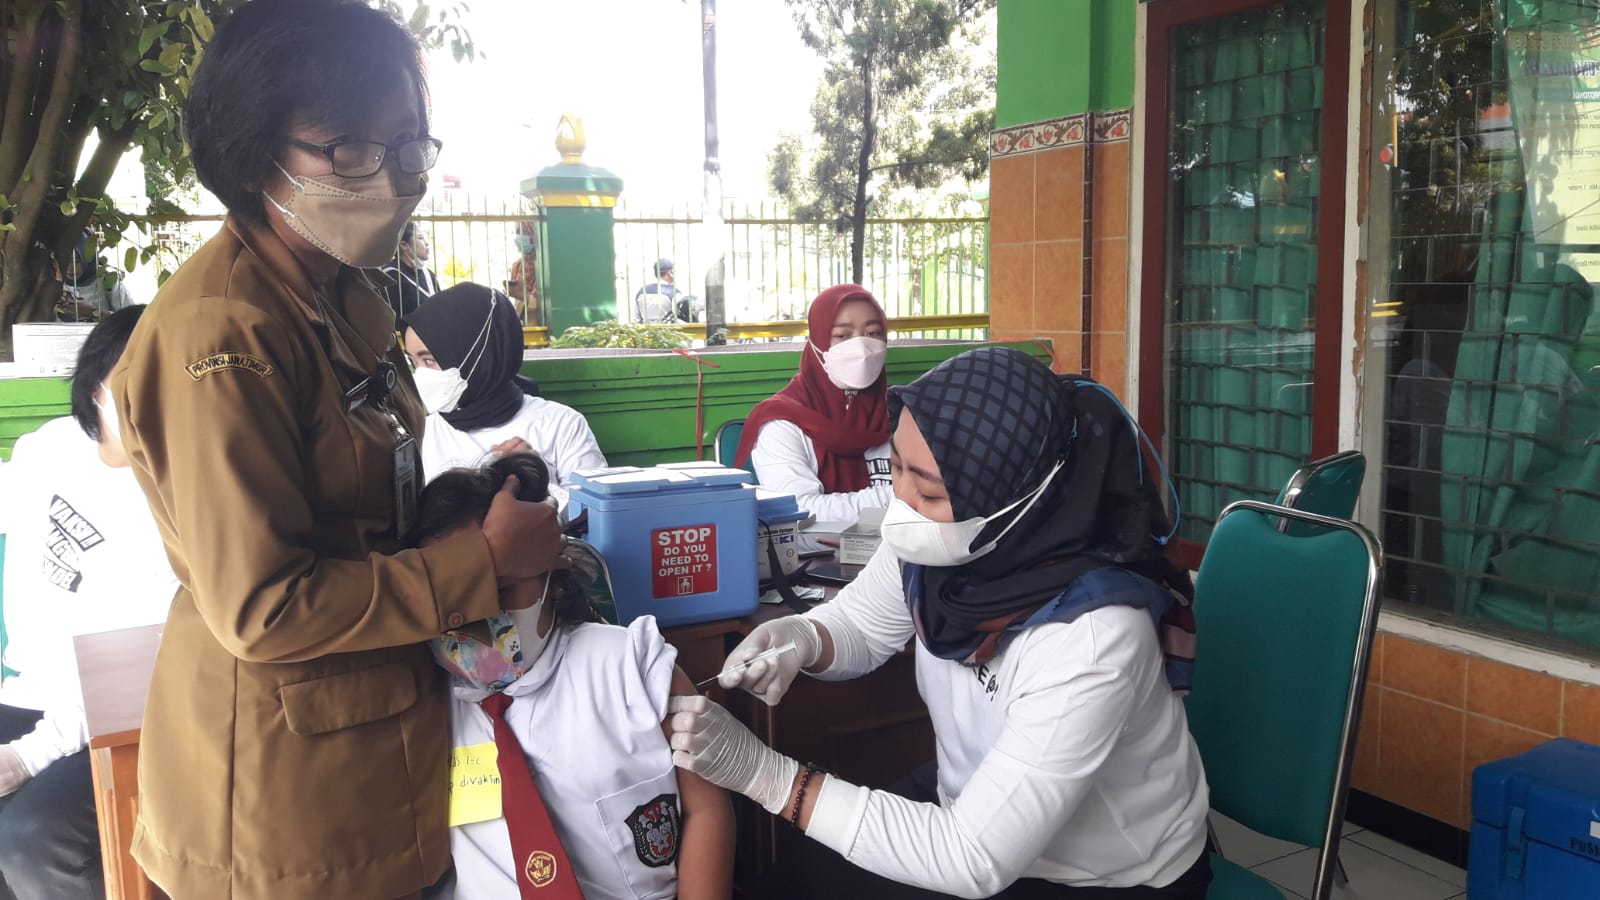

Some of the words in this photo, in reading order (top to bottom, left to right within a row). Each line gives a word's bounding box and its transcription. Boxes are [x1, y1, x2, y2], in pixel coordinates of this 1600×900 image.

[192, 354, 226, 375] PROVINSI
[658, 527, 712, 546] STOP
[664, 546, 680, 556] DO
[683, 544, 706, 554] YOU
[661, 556, 692, 567] NEED
[694, 553, 709, 563] TO
[658, 566, 689, 577] OPEN
[692, 564, 703, 573] IT
[706, 563, 712, 572] ?
[460, 773, 501, 788] divaksin
